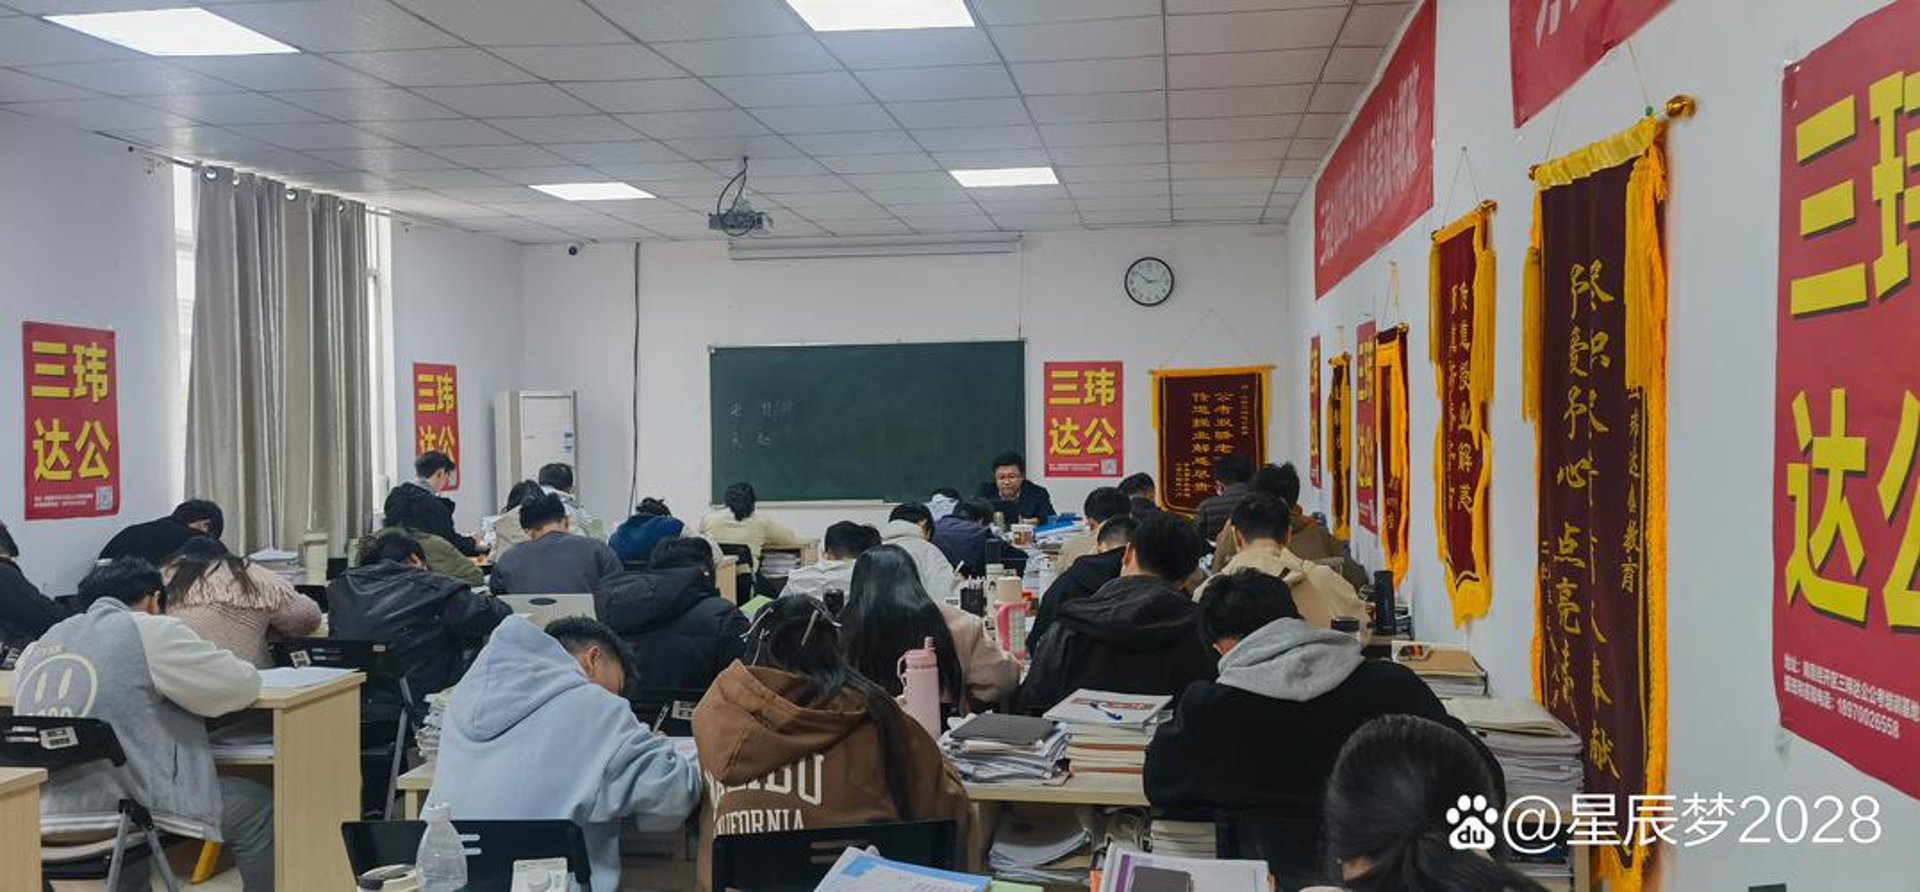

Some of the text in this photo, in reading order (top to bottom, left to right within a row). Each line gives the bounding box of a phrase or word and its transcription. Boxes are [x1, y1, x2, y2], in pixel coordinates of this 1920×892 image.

[31, 342, 109, 403] 三玮
[417, 372, 456, 415] 三玮
[1049, 368, 1116, 407] 三玮
[33, 418, 111, 483] 达公
[1049, 417, 1116, 457] 达公
